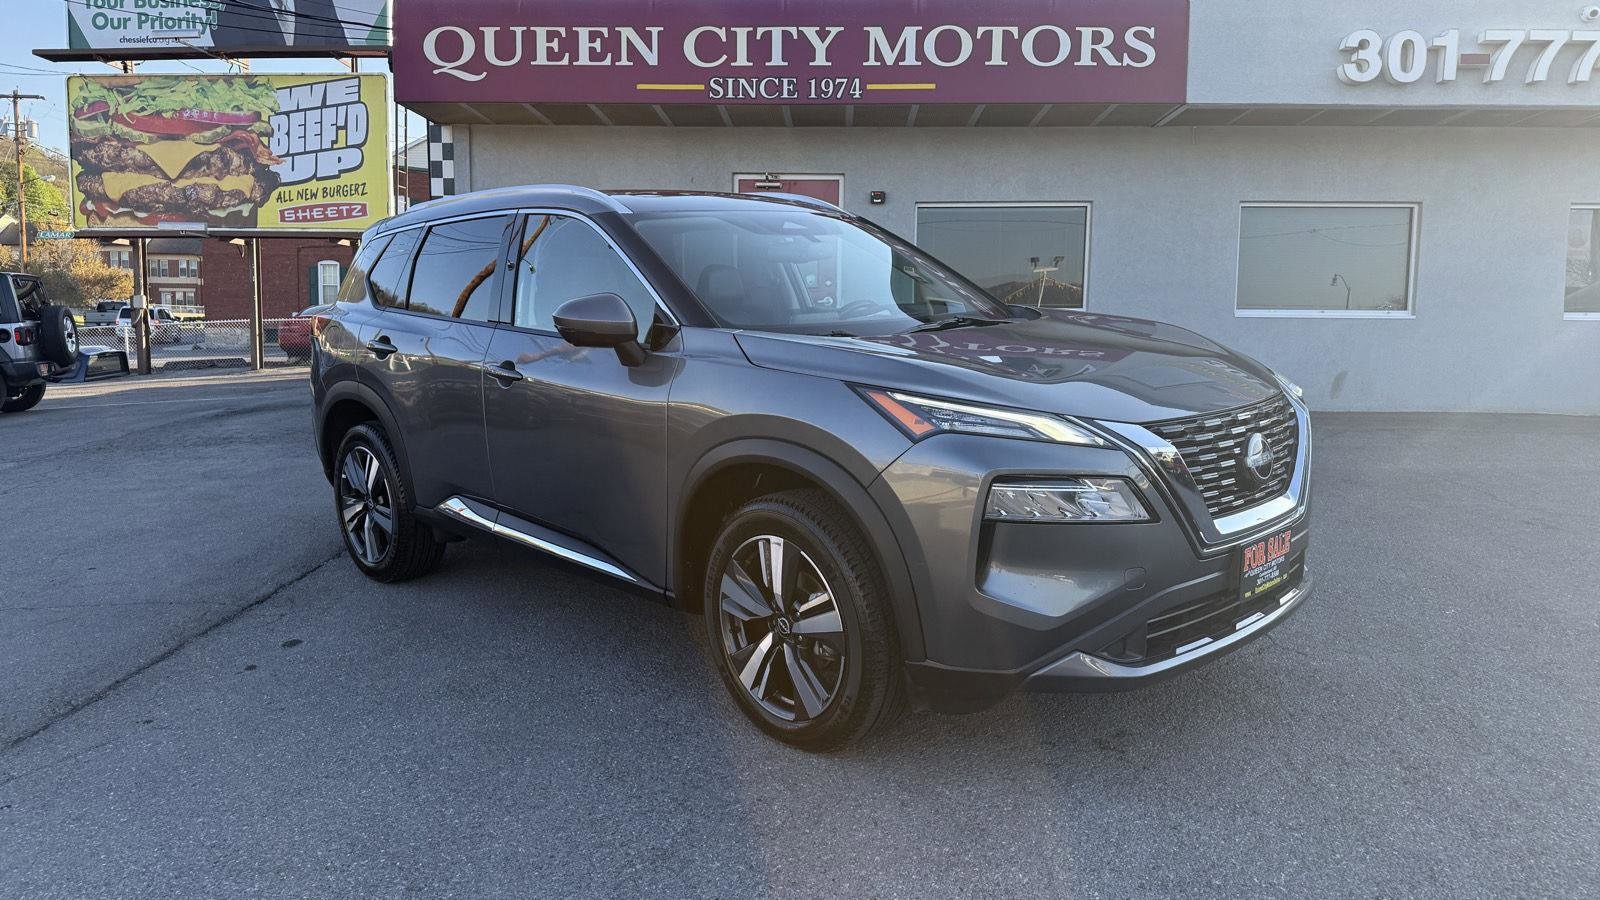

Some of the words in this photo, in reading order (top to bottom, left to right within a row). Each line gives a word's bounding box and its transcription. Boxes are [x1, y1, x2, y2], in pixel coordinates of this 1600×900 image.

[91, 11, 131, 30] Our
[137, 10, 218, 35] Priority!
[423, 26, 664, 82] QUEEN
[683, 25, 844, 68] CITY
[862, 24, 1157, 68] MOTORS
[1336, 29, 1600, 84] 301-777
[276, 77, 361, 113] WE
[709, 77, 798, 99] SINCE
[808, 78, 863, 99] 1974
[268, 102, 369, 157] BEEF'D
[270, 147, 364, 187] UP
[276, 190, 294, 204] ALL
[296, 187, 319, 201] NEW
[322, 182, 368, 199] BURGERZ
[284, 204, 363, 221] SHEETZ
[39, 230, 73, 240] LAMAR
[1243, 541, 1266, 572] FOR
[1267, 530, 1292, 562] SALE
